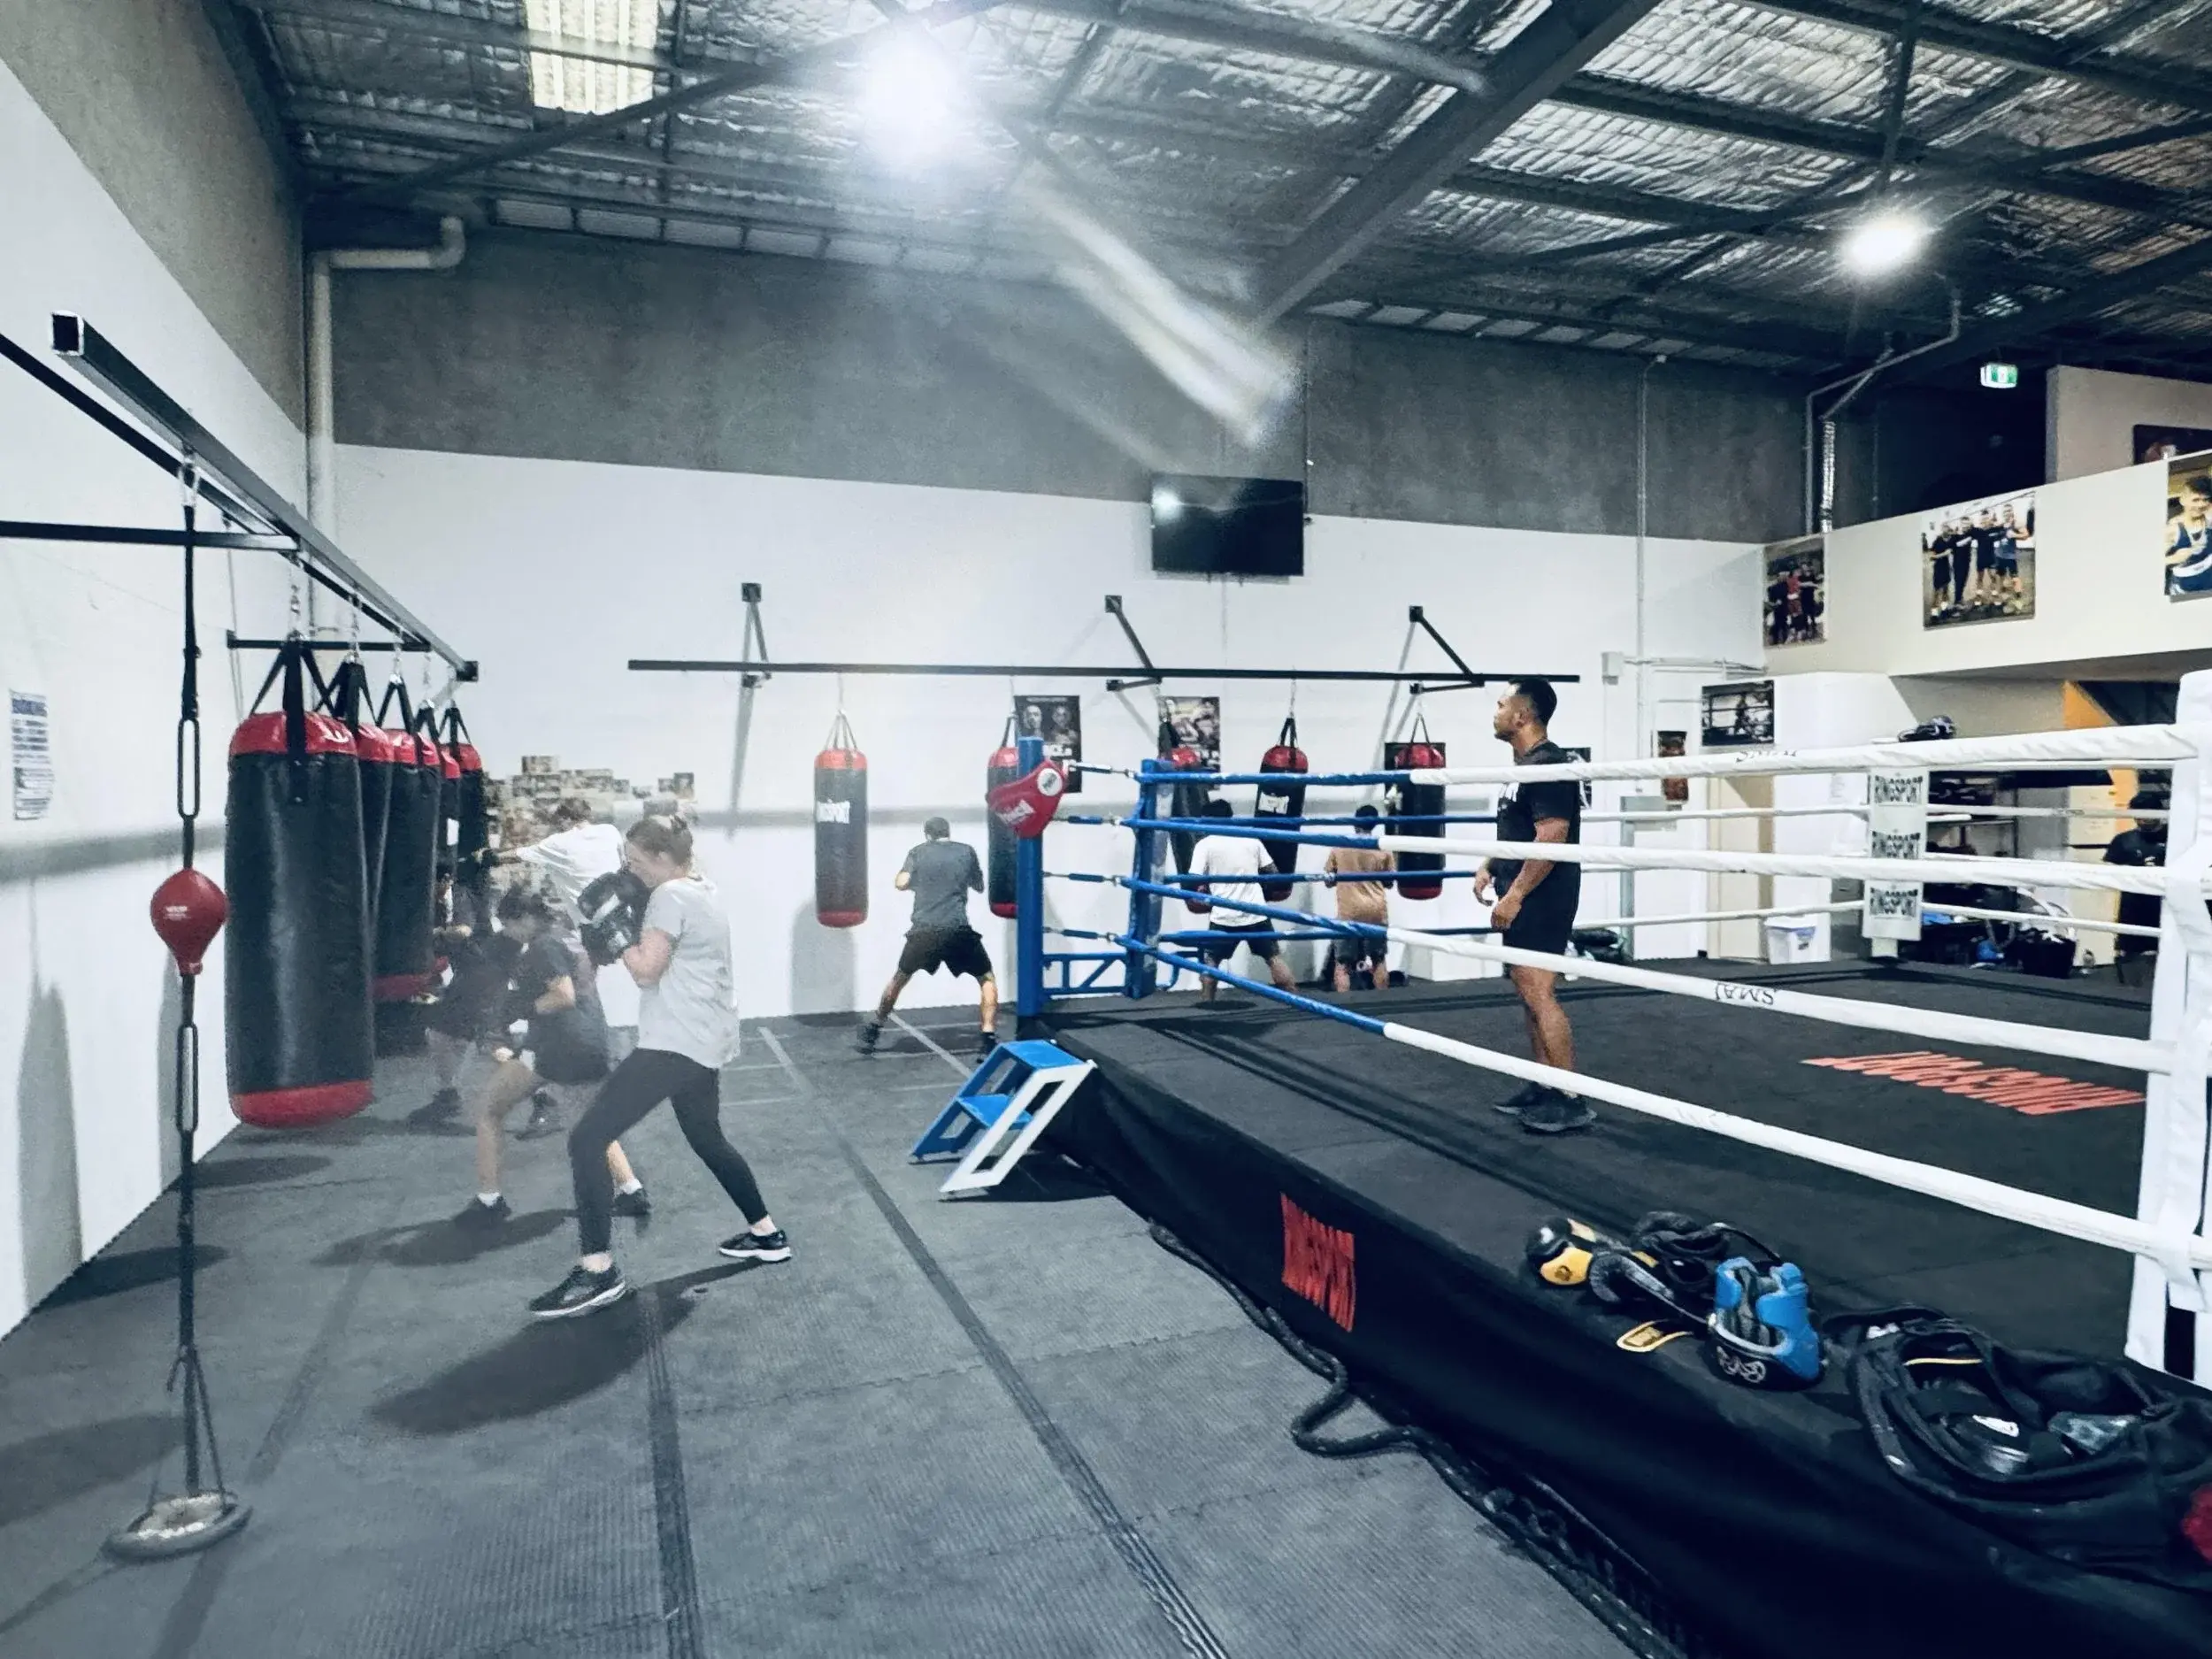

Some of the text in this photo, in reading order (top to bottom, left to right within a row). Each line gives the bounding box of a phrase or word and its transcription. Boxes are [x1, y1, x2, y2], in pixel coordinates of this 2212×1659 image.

[1875, 775, 1924, 803] RINGSPORT
[1870, 887, 1918, 917] RINGSPORT
[1715, 983, 1774, 1005] SMAI
[1799, 1050, 2147, 1115] RINGSPORT
